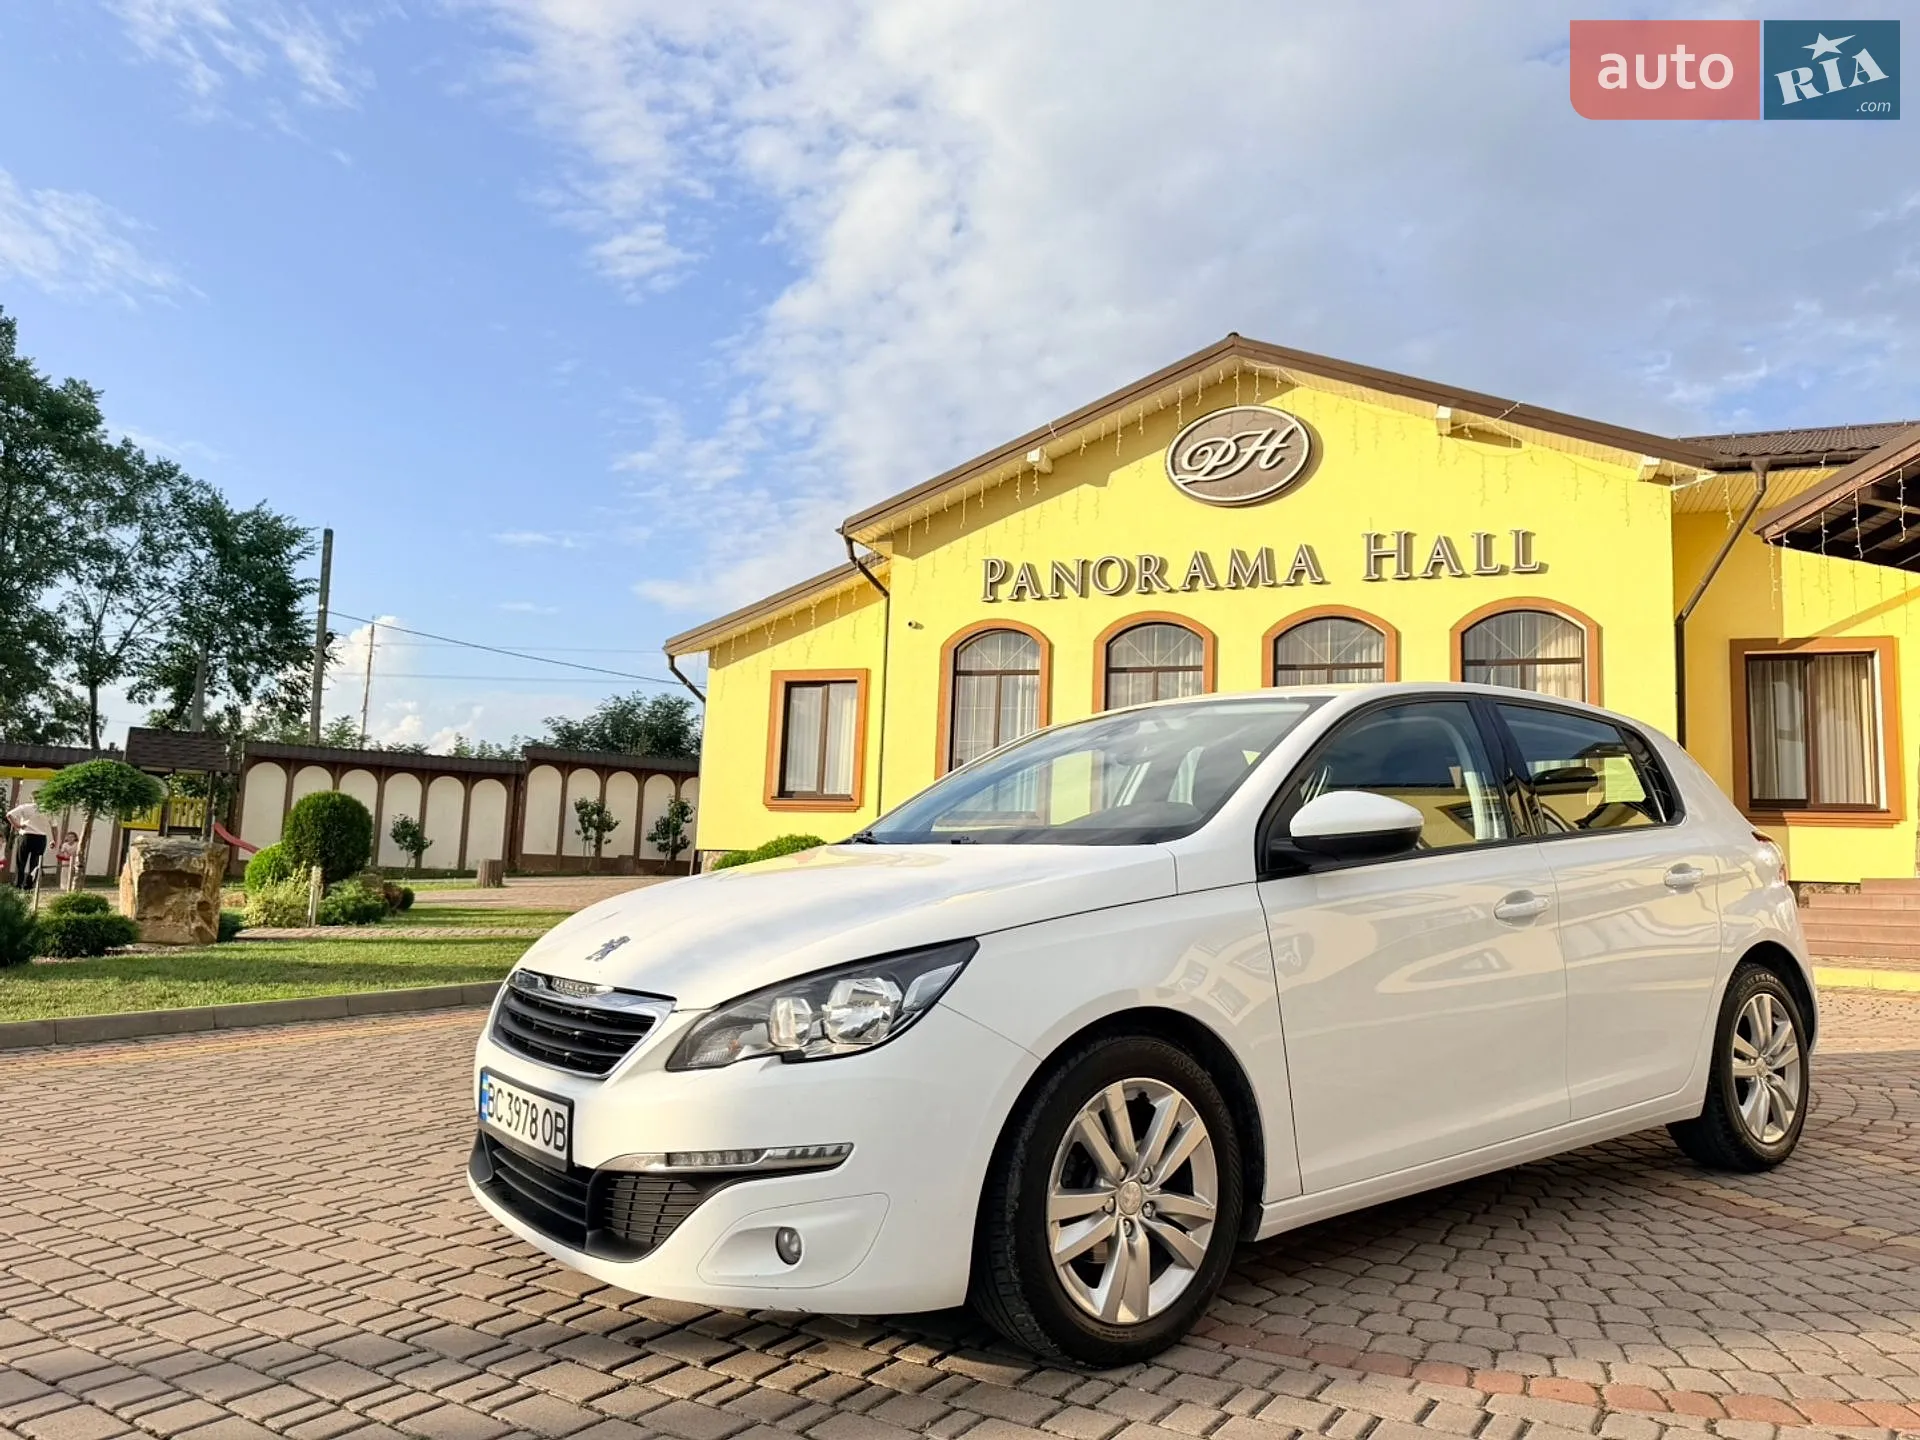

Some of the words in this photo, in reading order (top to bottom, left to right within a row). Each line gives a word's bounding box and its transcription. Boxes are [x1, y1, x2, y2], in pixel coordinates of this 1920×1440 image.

[982, 543, 1325, 602] PANORAMA
[1361, 530, 1541, 581] HALL
[506, 1091, 538, 1141] 3978
